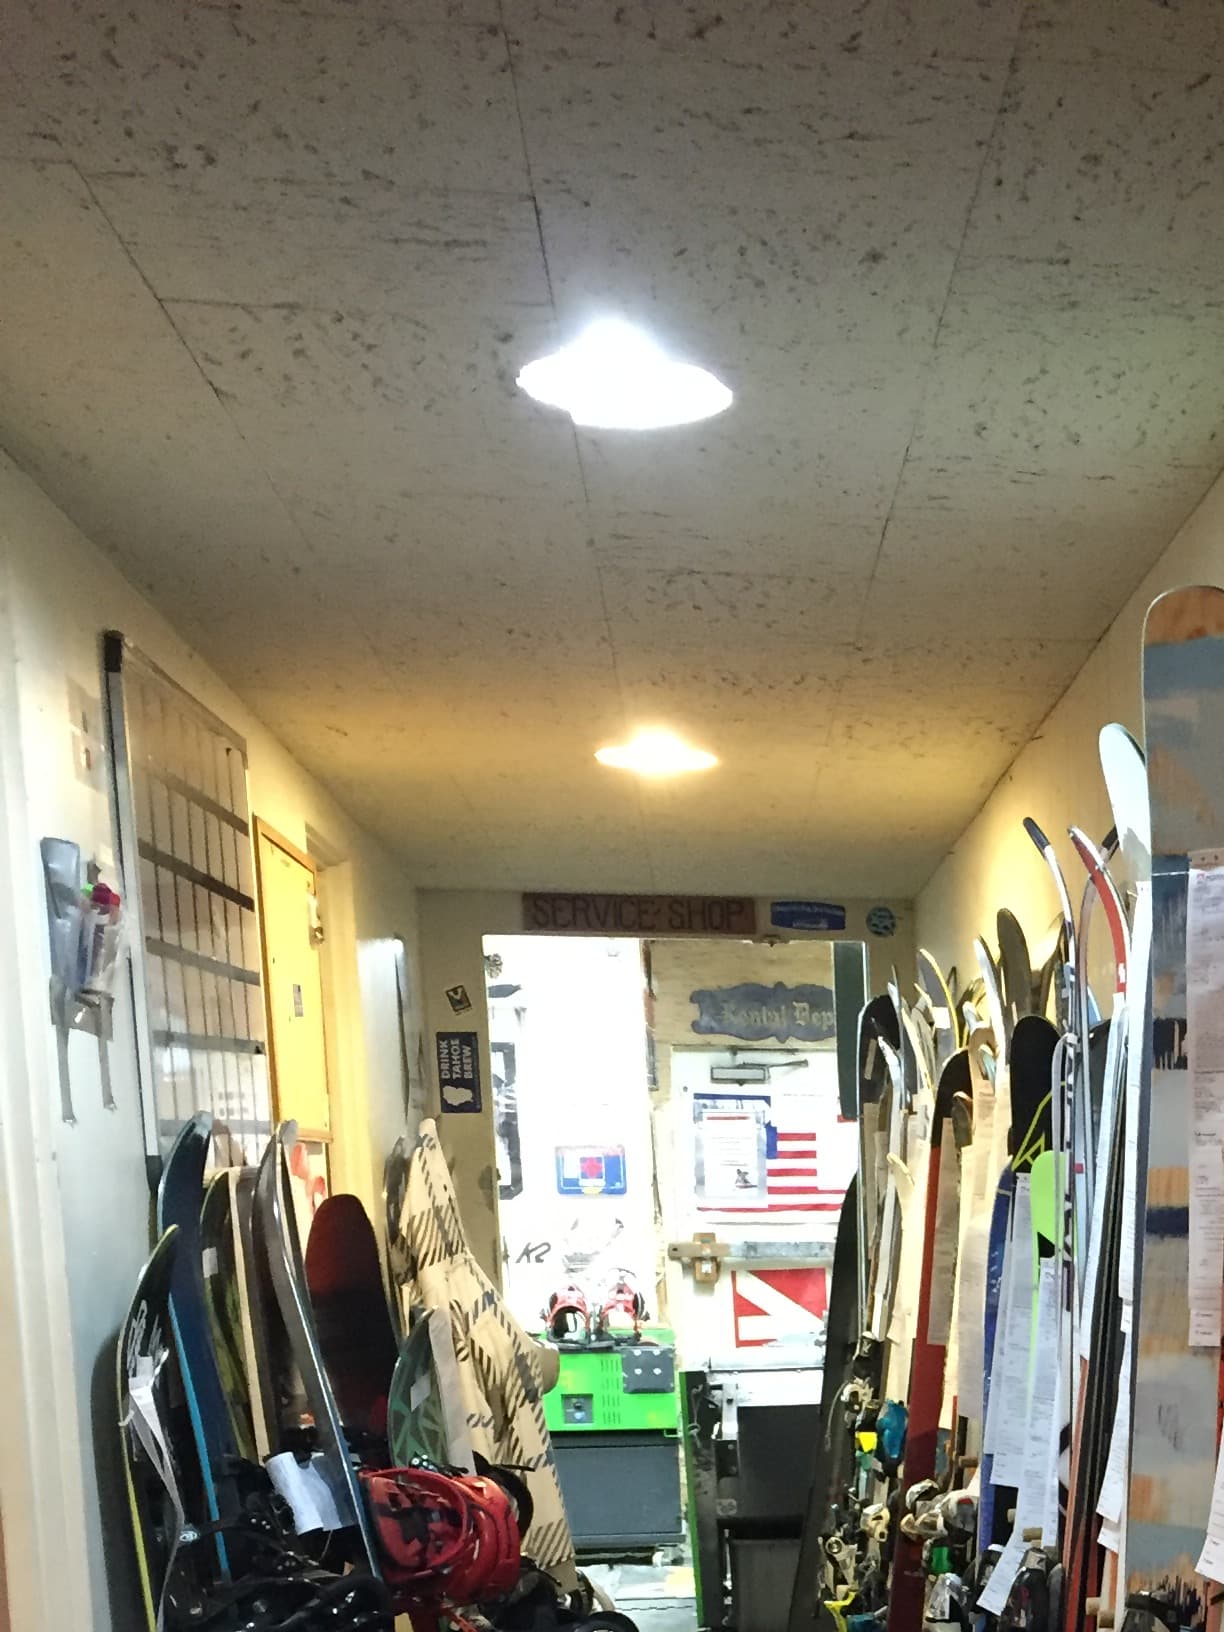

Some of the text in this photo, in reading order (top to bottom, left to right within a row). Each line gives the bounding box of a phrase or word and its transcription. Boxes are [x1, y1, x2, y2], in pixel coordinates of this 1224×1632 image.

[532, 897, 745, 930] SERVICE SHOP
[439, 1039, 451, 1079] DRINK
[450, 1037, 461, 1080] TAHOE
[463, 1045, 473, 1079] BREW
[515, 1241, 552, 1264] K2
